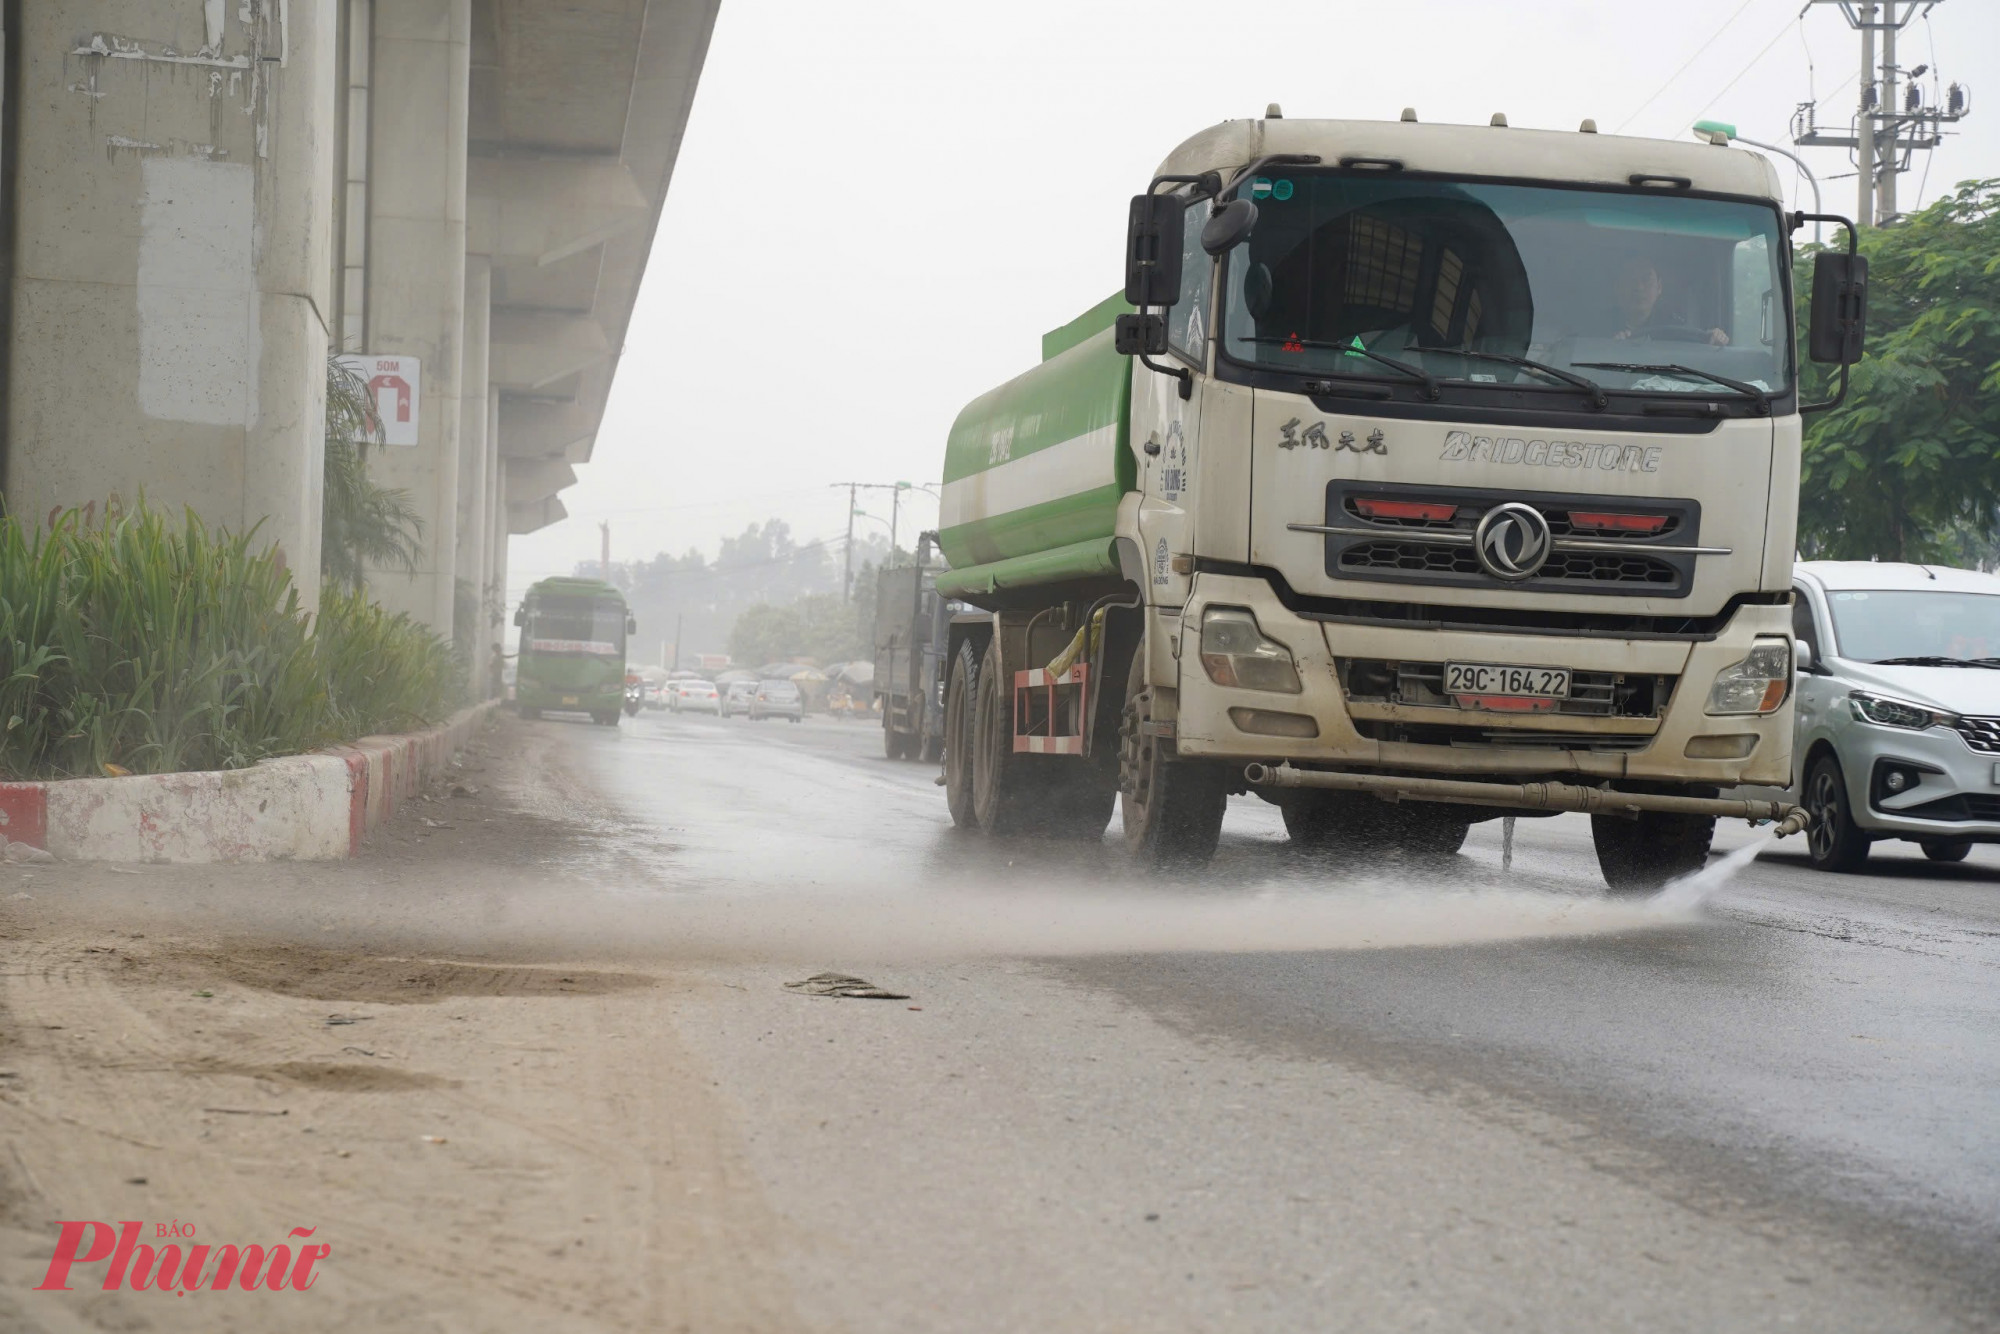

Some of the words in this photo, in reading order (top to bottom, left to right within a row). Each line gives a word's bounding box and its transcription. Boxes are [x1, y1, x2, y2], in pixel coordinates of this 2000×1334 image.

[376, 360, 400, 372] 50M
[1439, 430, 1663, 473] BRIDGESTONE
[1450, 666, 1566, 696] 29C-164.22
